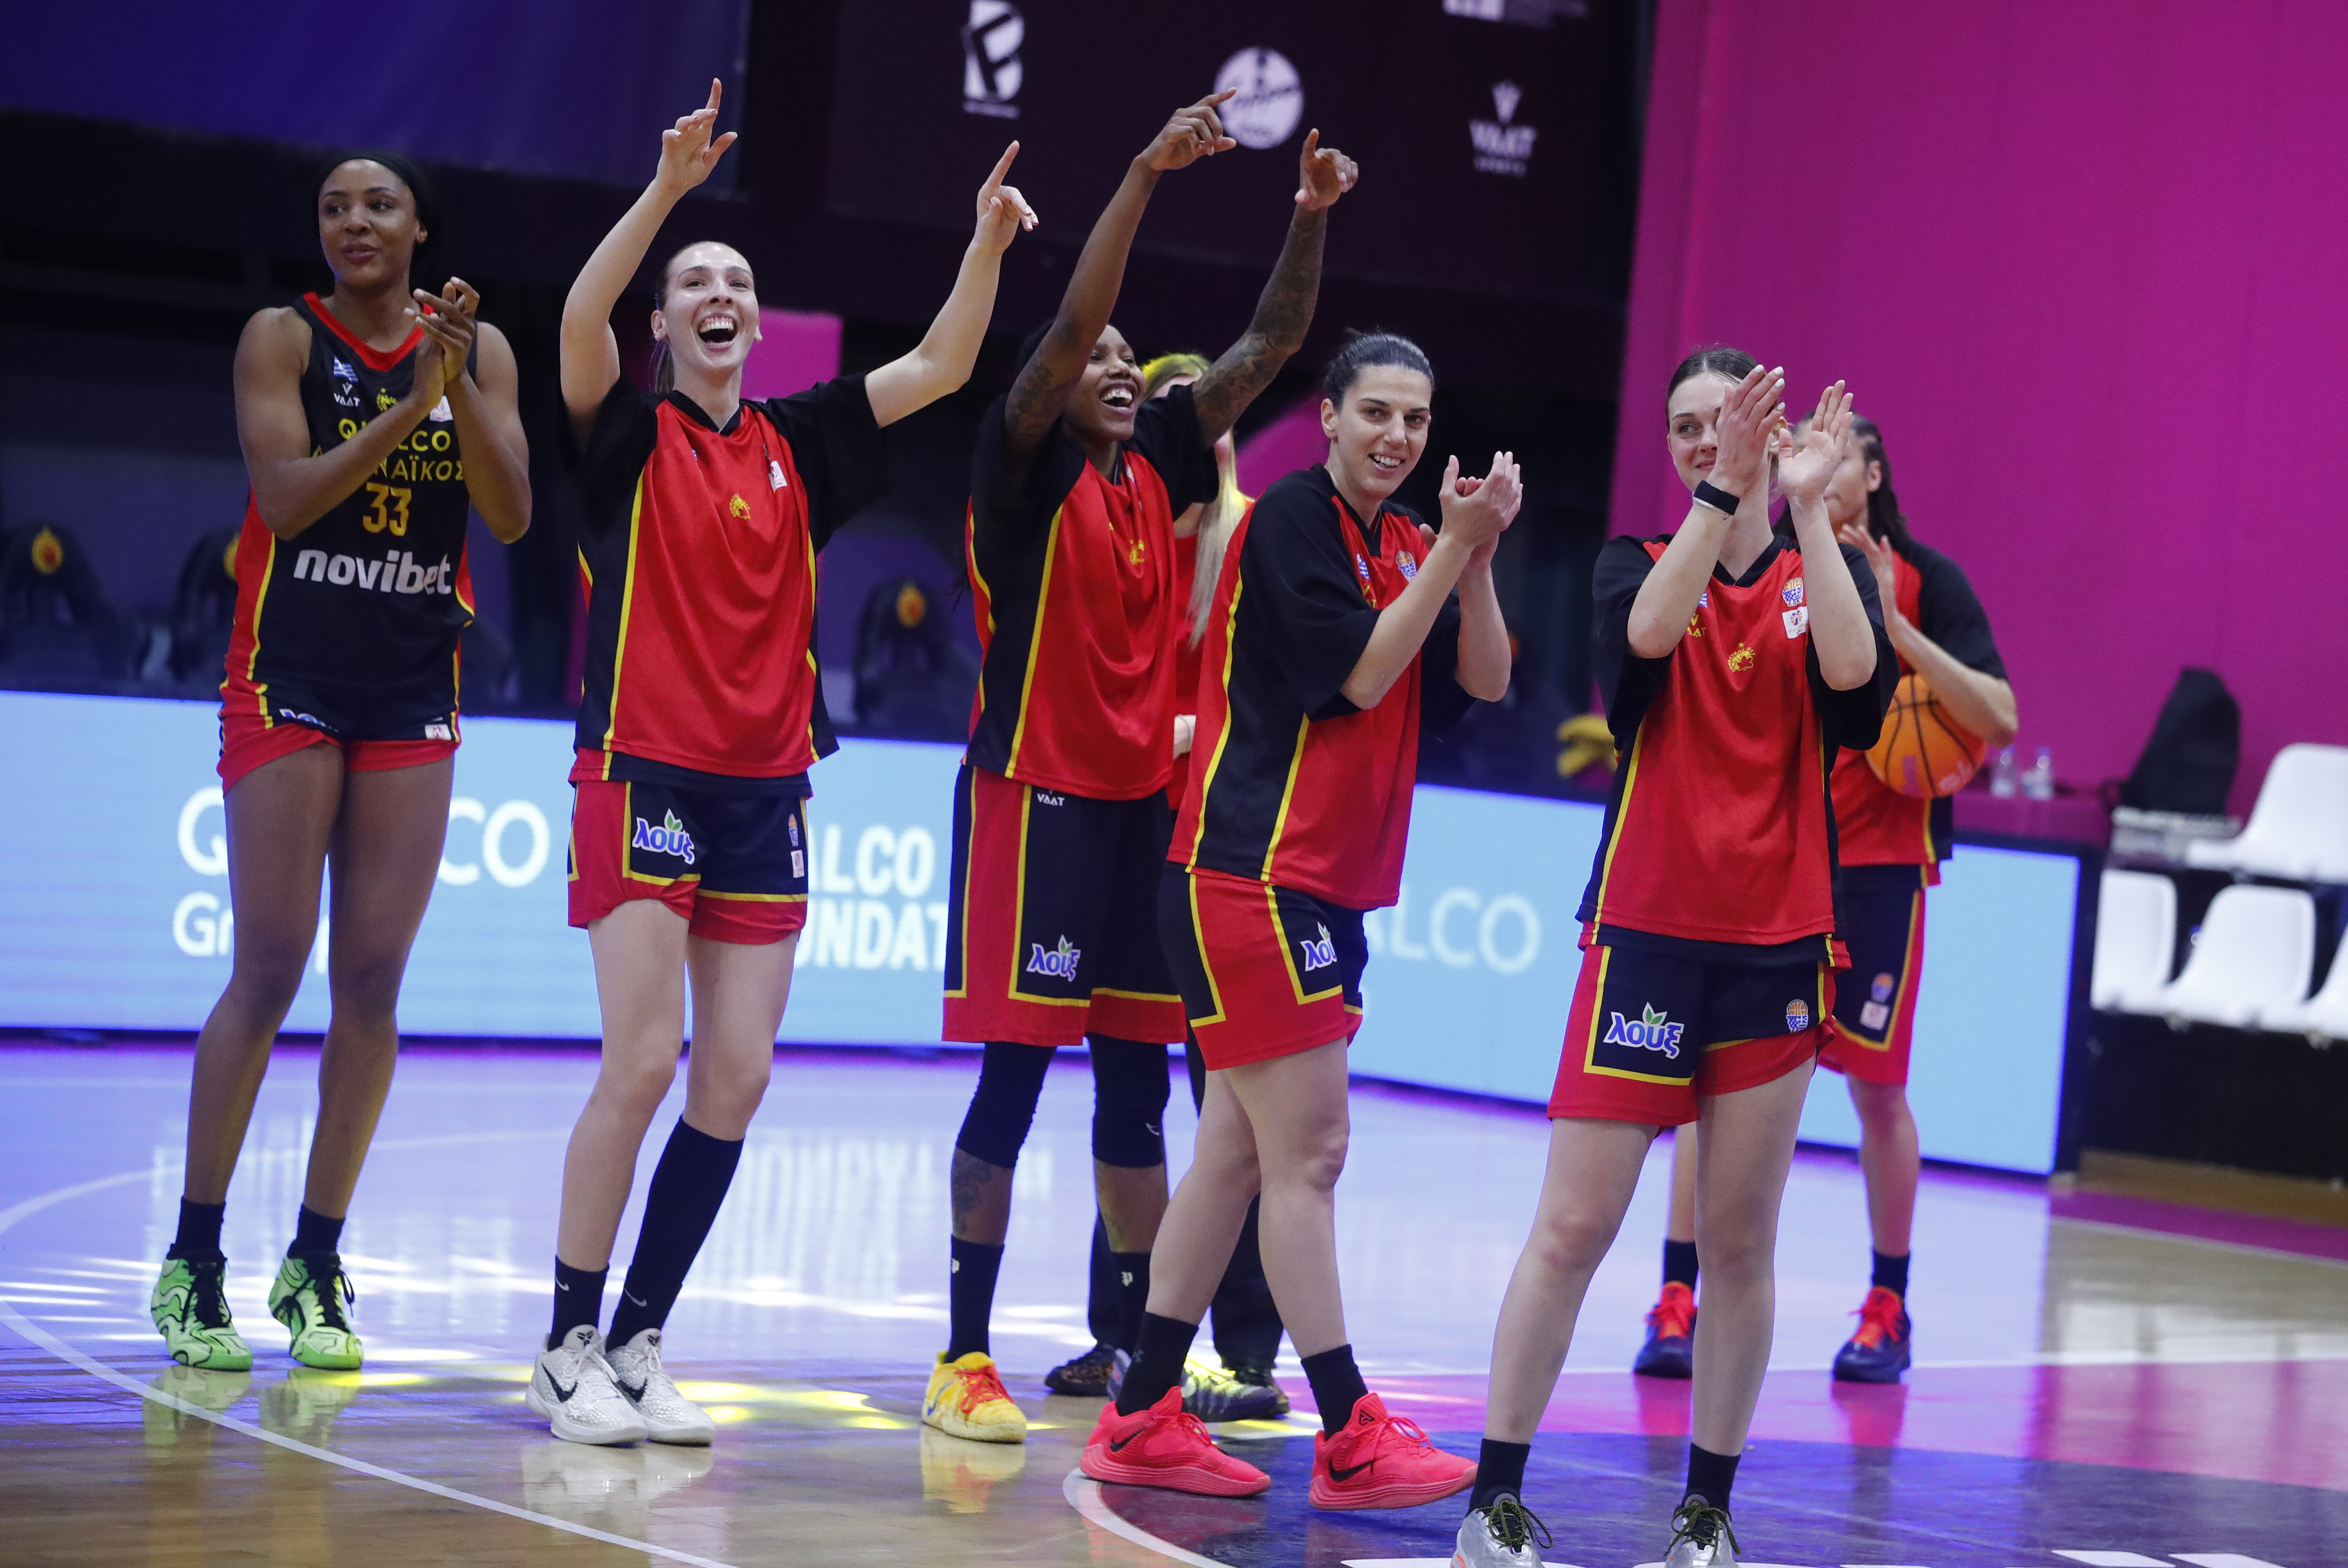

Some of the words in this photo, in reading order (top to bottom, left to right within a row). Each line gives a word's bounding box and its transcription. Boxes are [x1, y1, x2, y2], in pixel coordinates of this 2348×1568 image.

[333, 392, 360, 407] VAAT
[338, 418, 451, 452] QCO
[363, 481, 412, 536] 33
[294, 549, 452, 595] novibet
[1687, 626, 1706, 637] AAT
[1037, 793, 1065, 806] VAAT
[177, 787, 551, 888] QCO
[808, 824, 936, 896] LCO
[793, 899, 949, 971] UNDAT
[1363, 883, 1542, 975] LCO
[1603, 1011, 1685, 1060] λουξ
